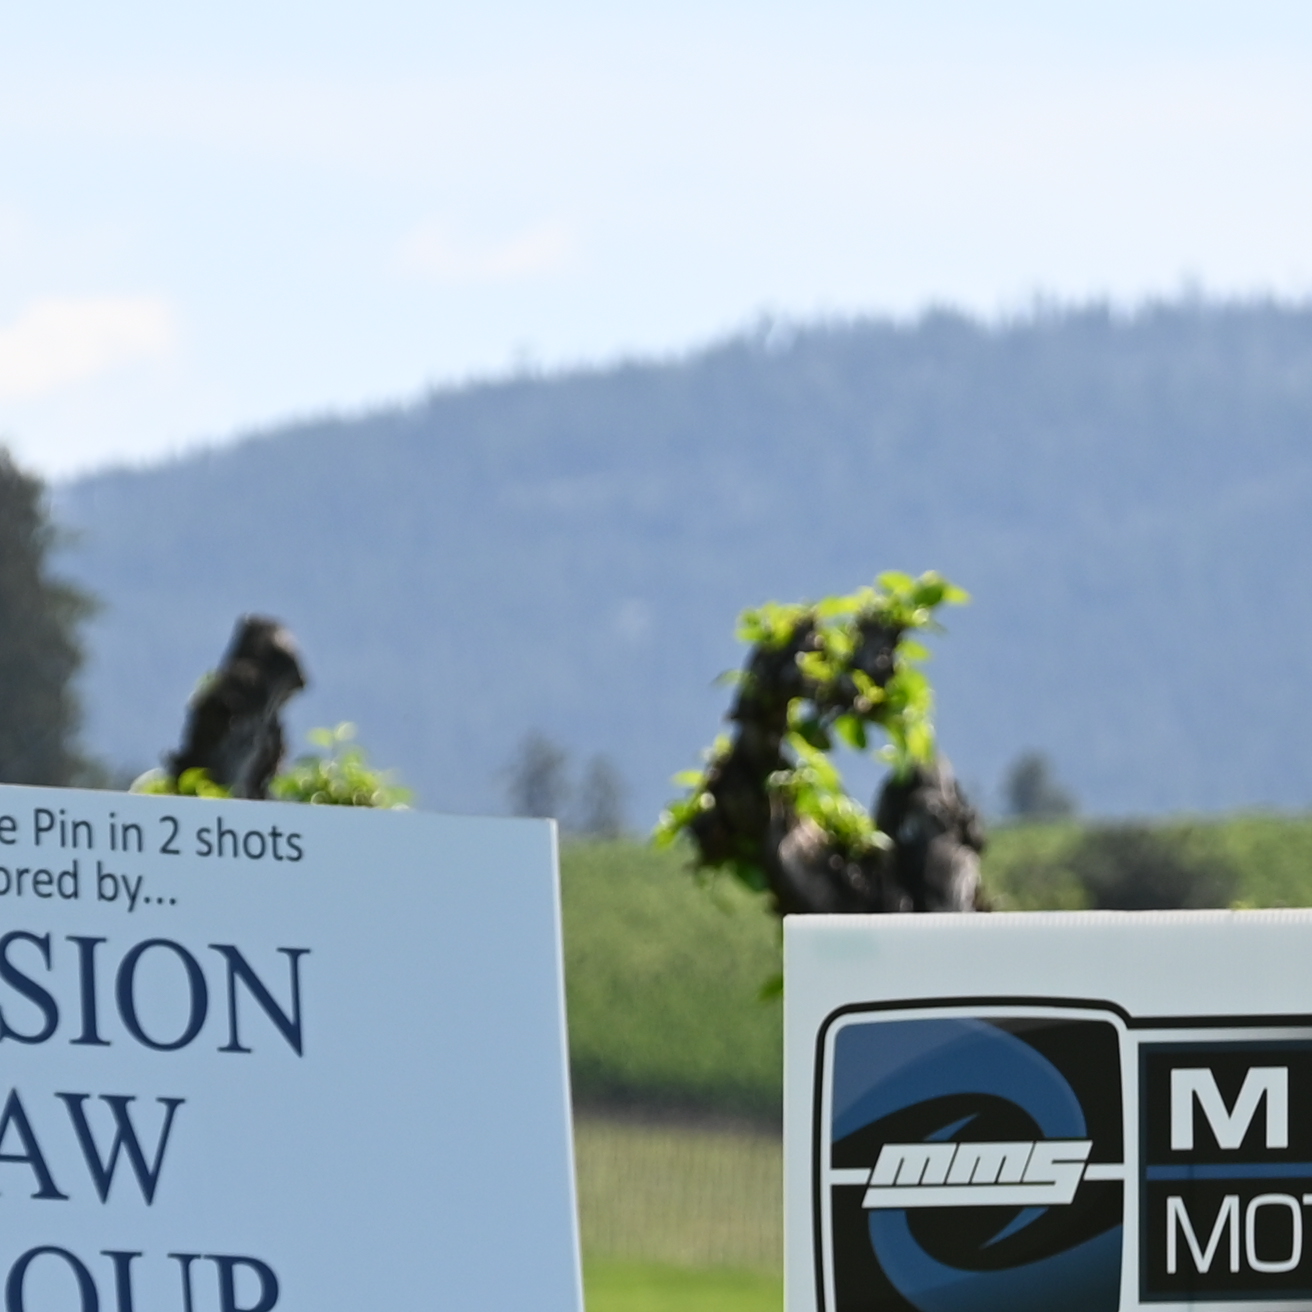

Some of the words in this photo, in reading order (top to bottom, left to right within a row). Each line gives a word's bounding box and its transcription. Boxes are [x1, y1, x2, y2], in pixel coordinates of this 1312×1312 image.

[33, 807, 94, 850] Pin
[108, 811, 144, 853] in
[159, 815, 181, 856] 2
[195, 816, 304, 863] shots
[96, 860, 178, 911] by...
